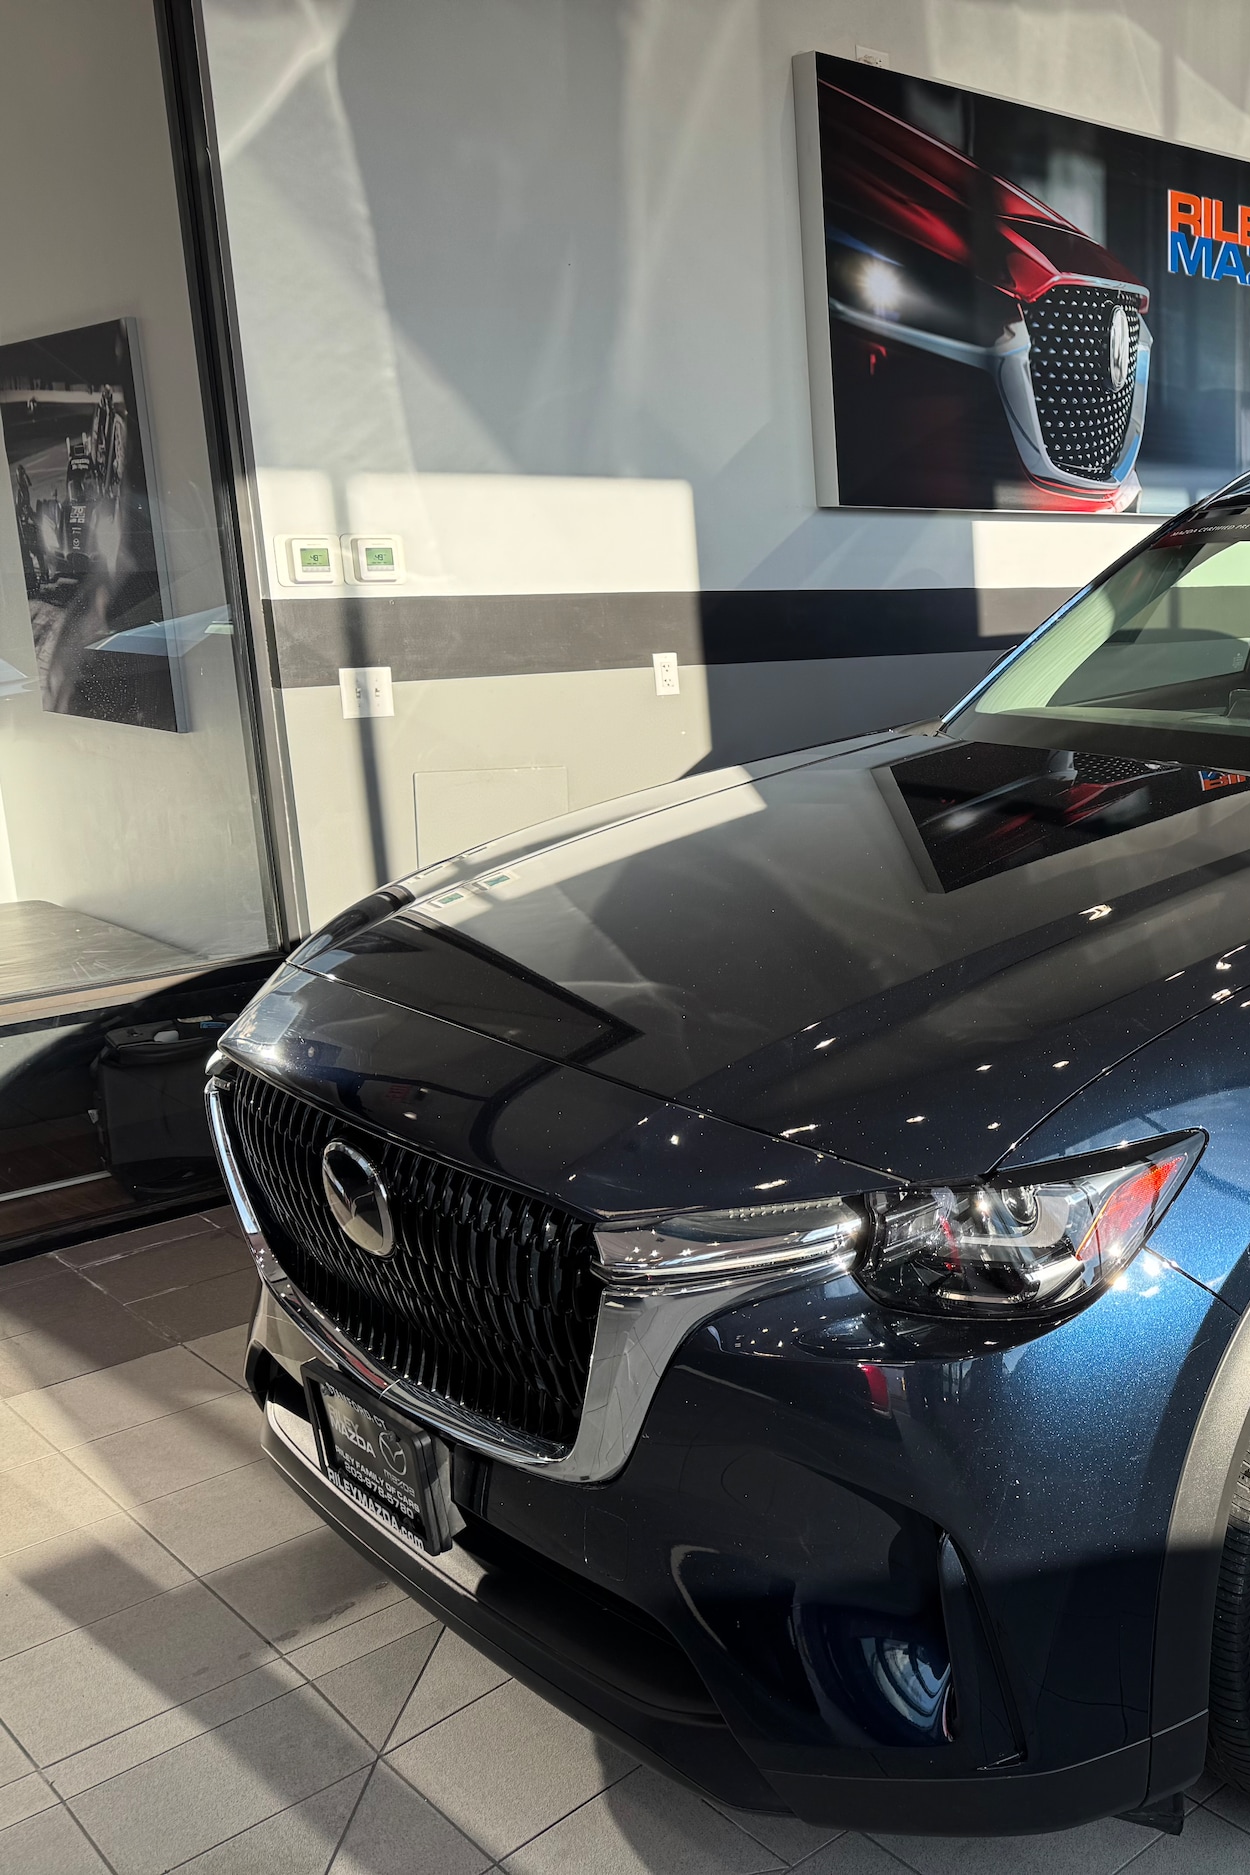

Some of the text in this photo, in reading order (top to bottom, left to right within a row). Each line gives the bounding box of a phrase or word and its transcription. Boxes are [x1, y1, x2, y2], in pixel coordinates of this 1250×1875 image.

[1170, 528, 1197, 537] MAZDA
[1198, 524, 1235, 533] CERTIFIED
[327, 1403, 359, 1435] RILEY
[329, 1413, 377, 1459] MAZDA
[335, 1444, 421, 1513] RILEY FAMILY OF CARS
